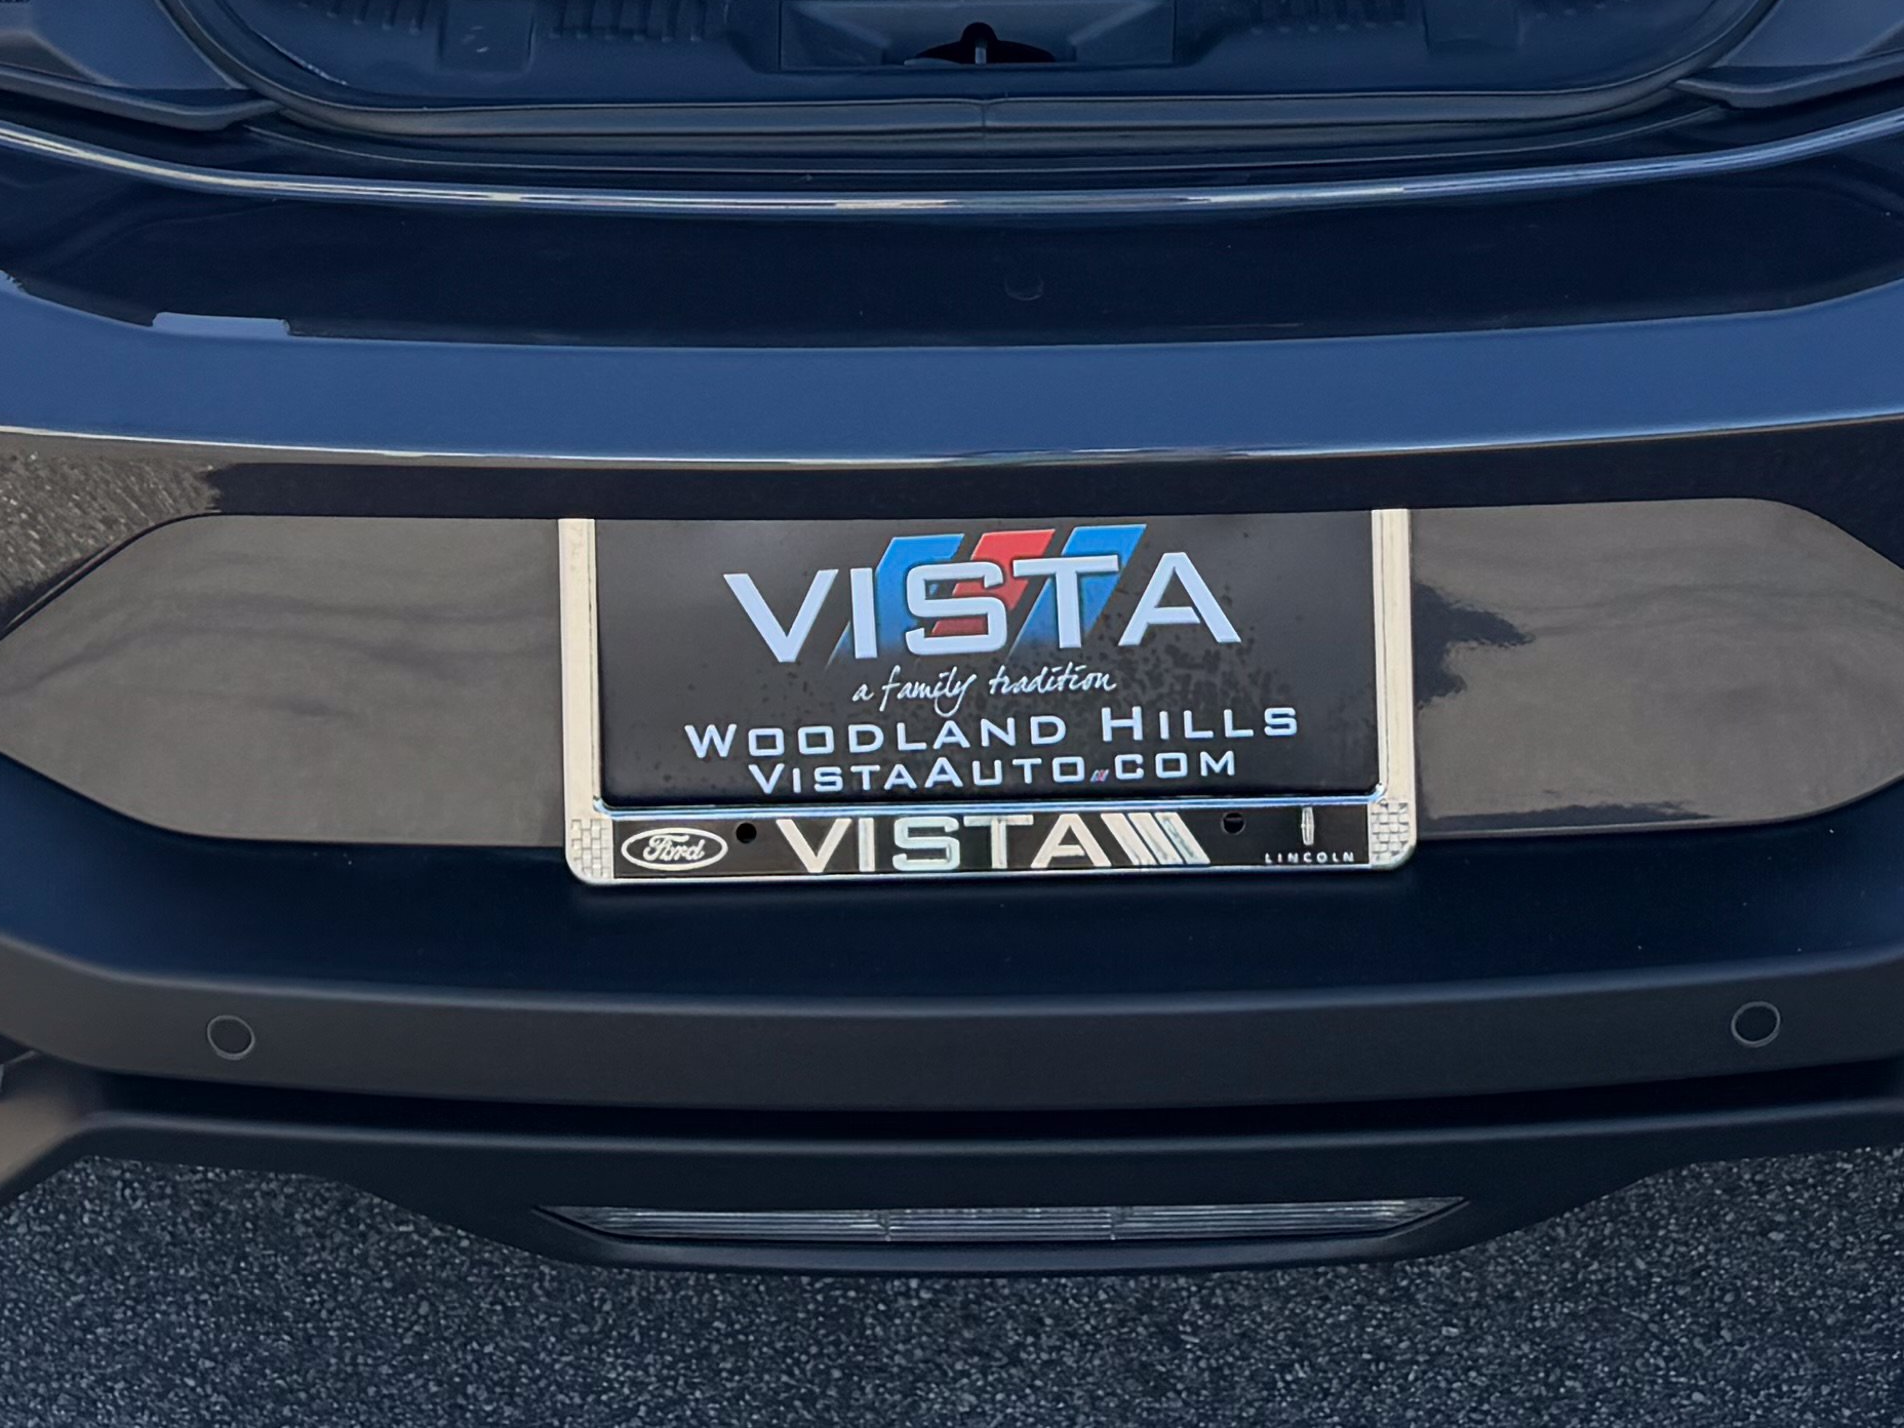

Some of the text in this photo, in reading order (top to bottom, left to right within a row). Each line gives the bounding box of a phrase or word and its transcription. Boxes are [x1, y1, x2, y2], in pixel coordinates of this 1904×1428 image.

[723, 552, 1242, 663] VISTA
[852, 661, 1117, 717] a family tradition
[684, 706, 1298, 759] WOODLAND HILLS
[642, 834, 706, 862] Ford
[776, 813, 1112, 874] VISTA
[1264, 850, 1356, 864] LINCOLN
